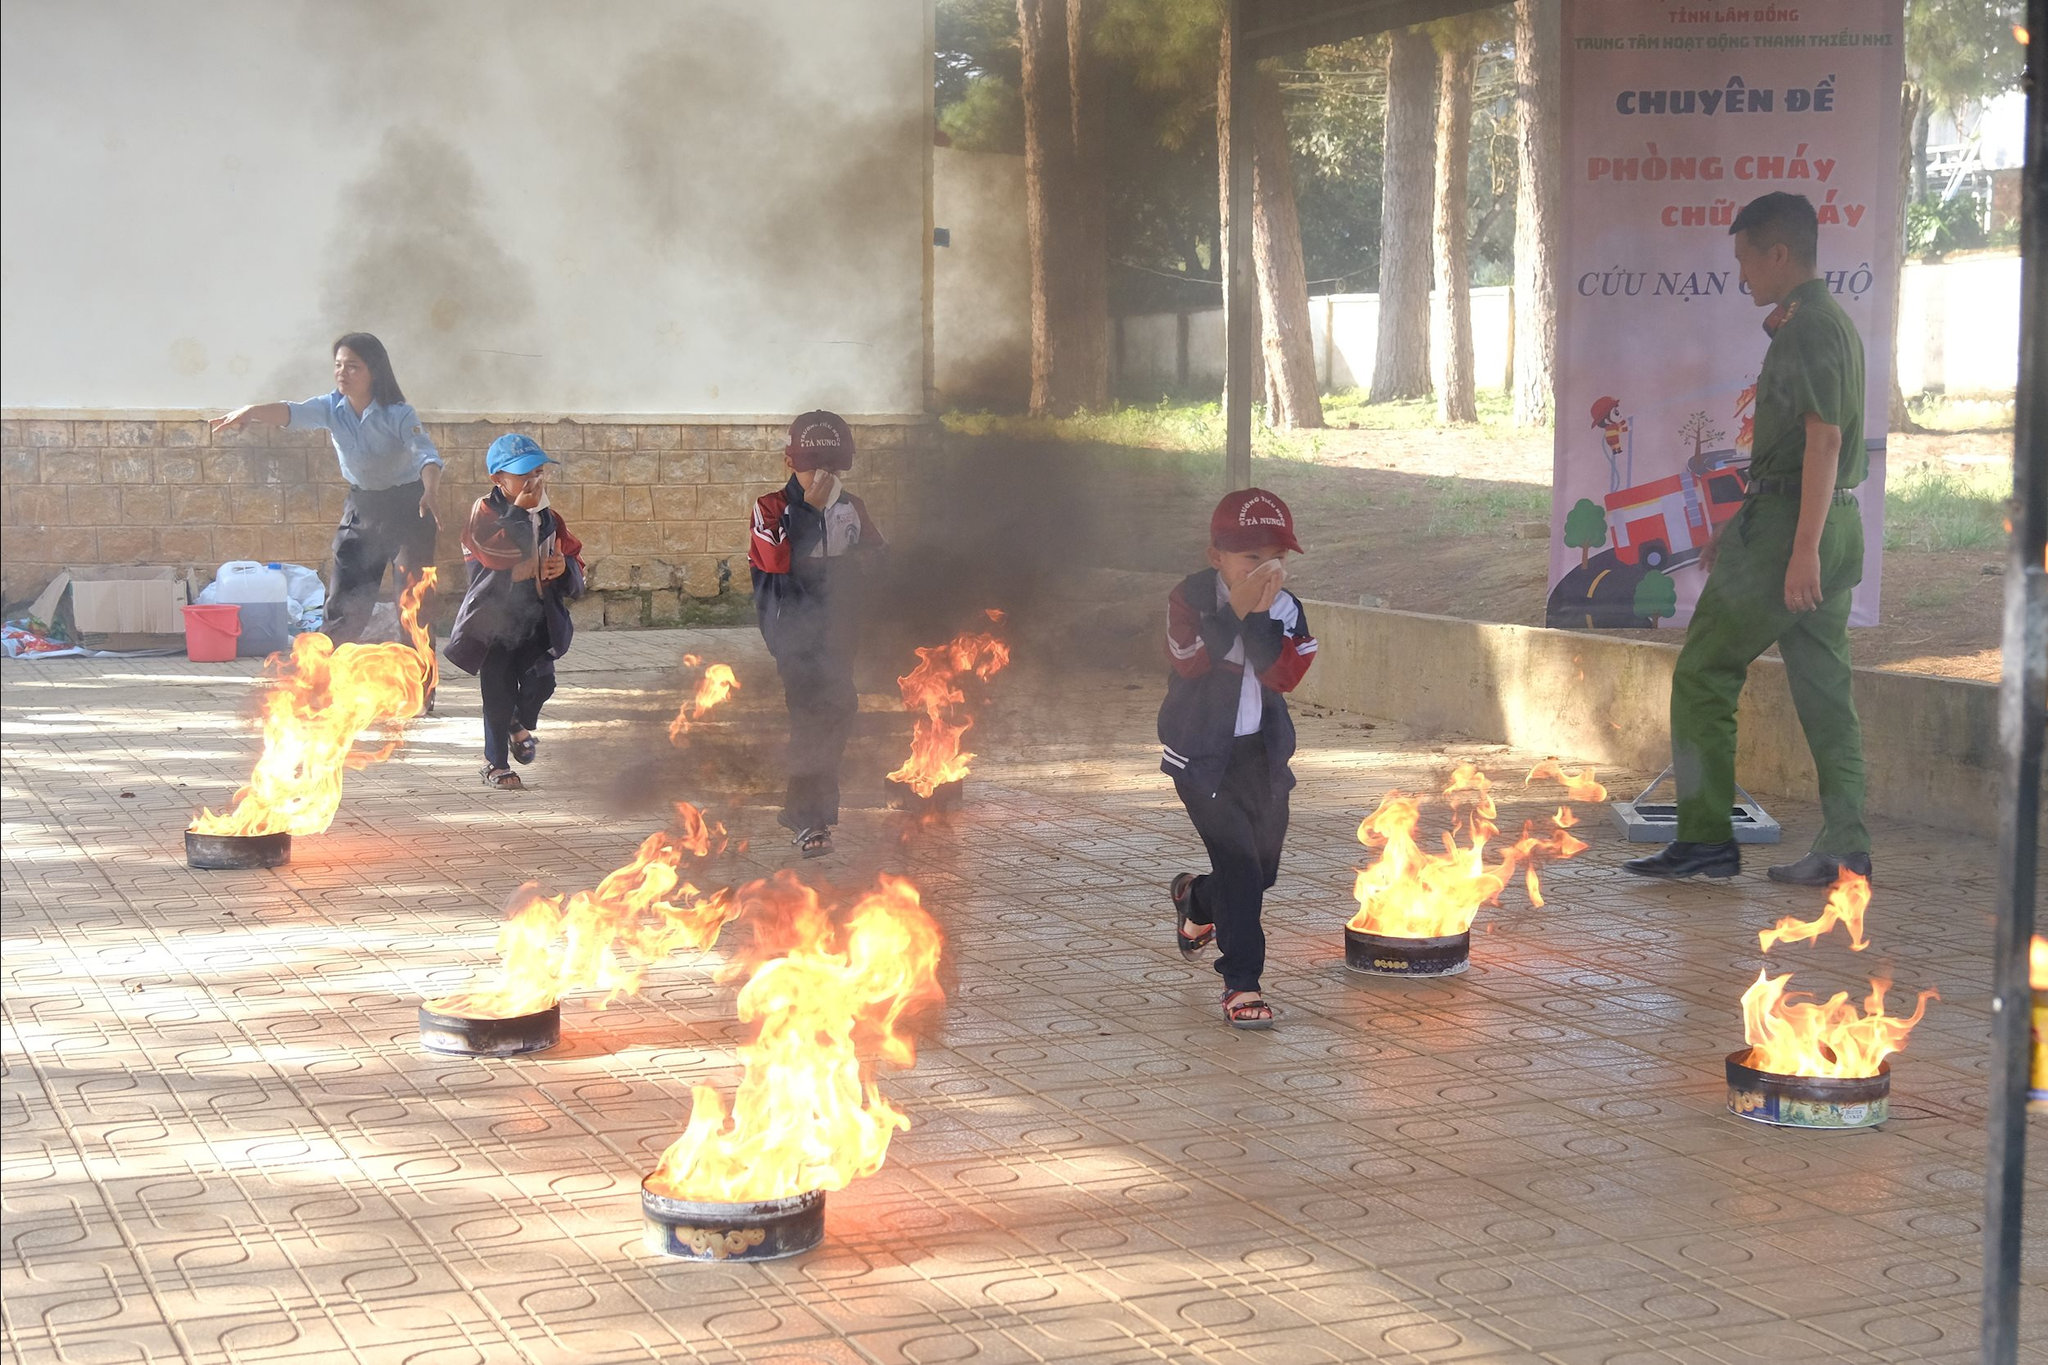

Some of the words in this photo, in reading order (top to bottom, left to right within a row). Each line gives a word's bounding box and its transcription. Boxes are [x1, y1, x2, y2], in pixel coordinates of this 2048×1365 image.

[1715, 7, 1749, 23] LÂM
[1574, 37, 1625, 50] TRUNG
[1628, 34, 1660, 49] TÂM
[1663, 36, 1705, 52] HOẠT
[1706, 33, 1750, 52] ĐỘNG
[1754, 35, 1806, 48] THANH
[1809, 27, 1860, 47] THIẾU
[1862, 34, 1894, 47] NHI
[1616, 75, 1774, 116] CHUYÊN
[1784, 73, 1837, 112] ĐỀ
[1587, 142, 1724, 182] PHÒNG
[1734, 143, 1837, 182] CHÁY
[1661, 198, 1745, 227] CHỮ
[1817, 189, 1867, 228] ÁY
[1577, 265, 1647, 297] CỨU
[1652, 271, 1731, 302] NẠN
[1824, 262, 1874, 301] HỘ
[1260, 517, 1282, 527] NUNG
